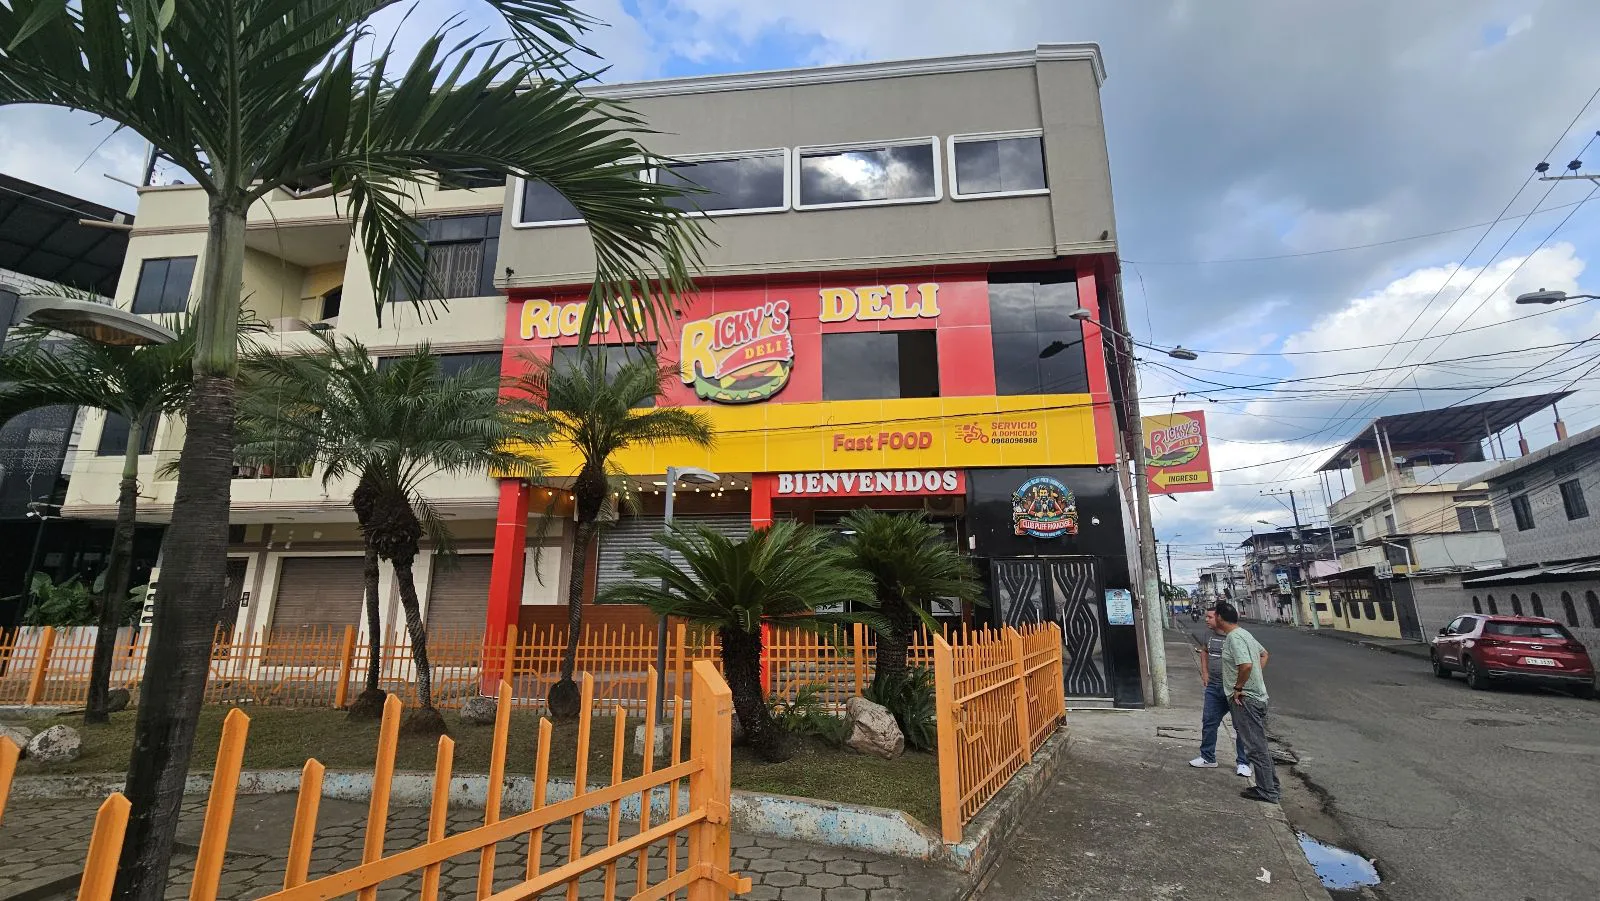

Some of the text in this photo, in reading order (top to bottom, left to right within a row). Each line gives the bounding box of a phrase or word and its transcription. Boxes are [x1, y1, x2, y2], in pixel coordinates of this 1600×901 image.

[819, 283, 940, 322] DELI
[520, 296, 646, 341] RIC'
[680, 300, 789, 383] RICKY'S
[744, 340, 782, 360] DELI
[991, 421, 1037, 430] SERVICIO
[833, 431, 932, 451] Fast FOOD
[1150, 420, 1200, 457] RICKY'S
[1179, 437, 1198, 447] DELI
[778, 470, 958, 494] BIENVENIDOS
[1168, 474, 1198, 483] INGRESO
[1022, 519, 1072, 530] CLUB PUFF PARADISE
